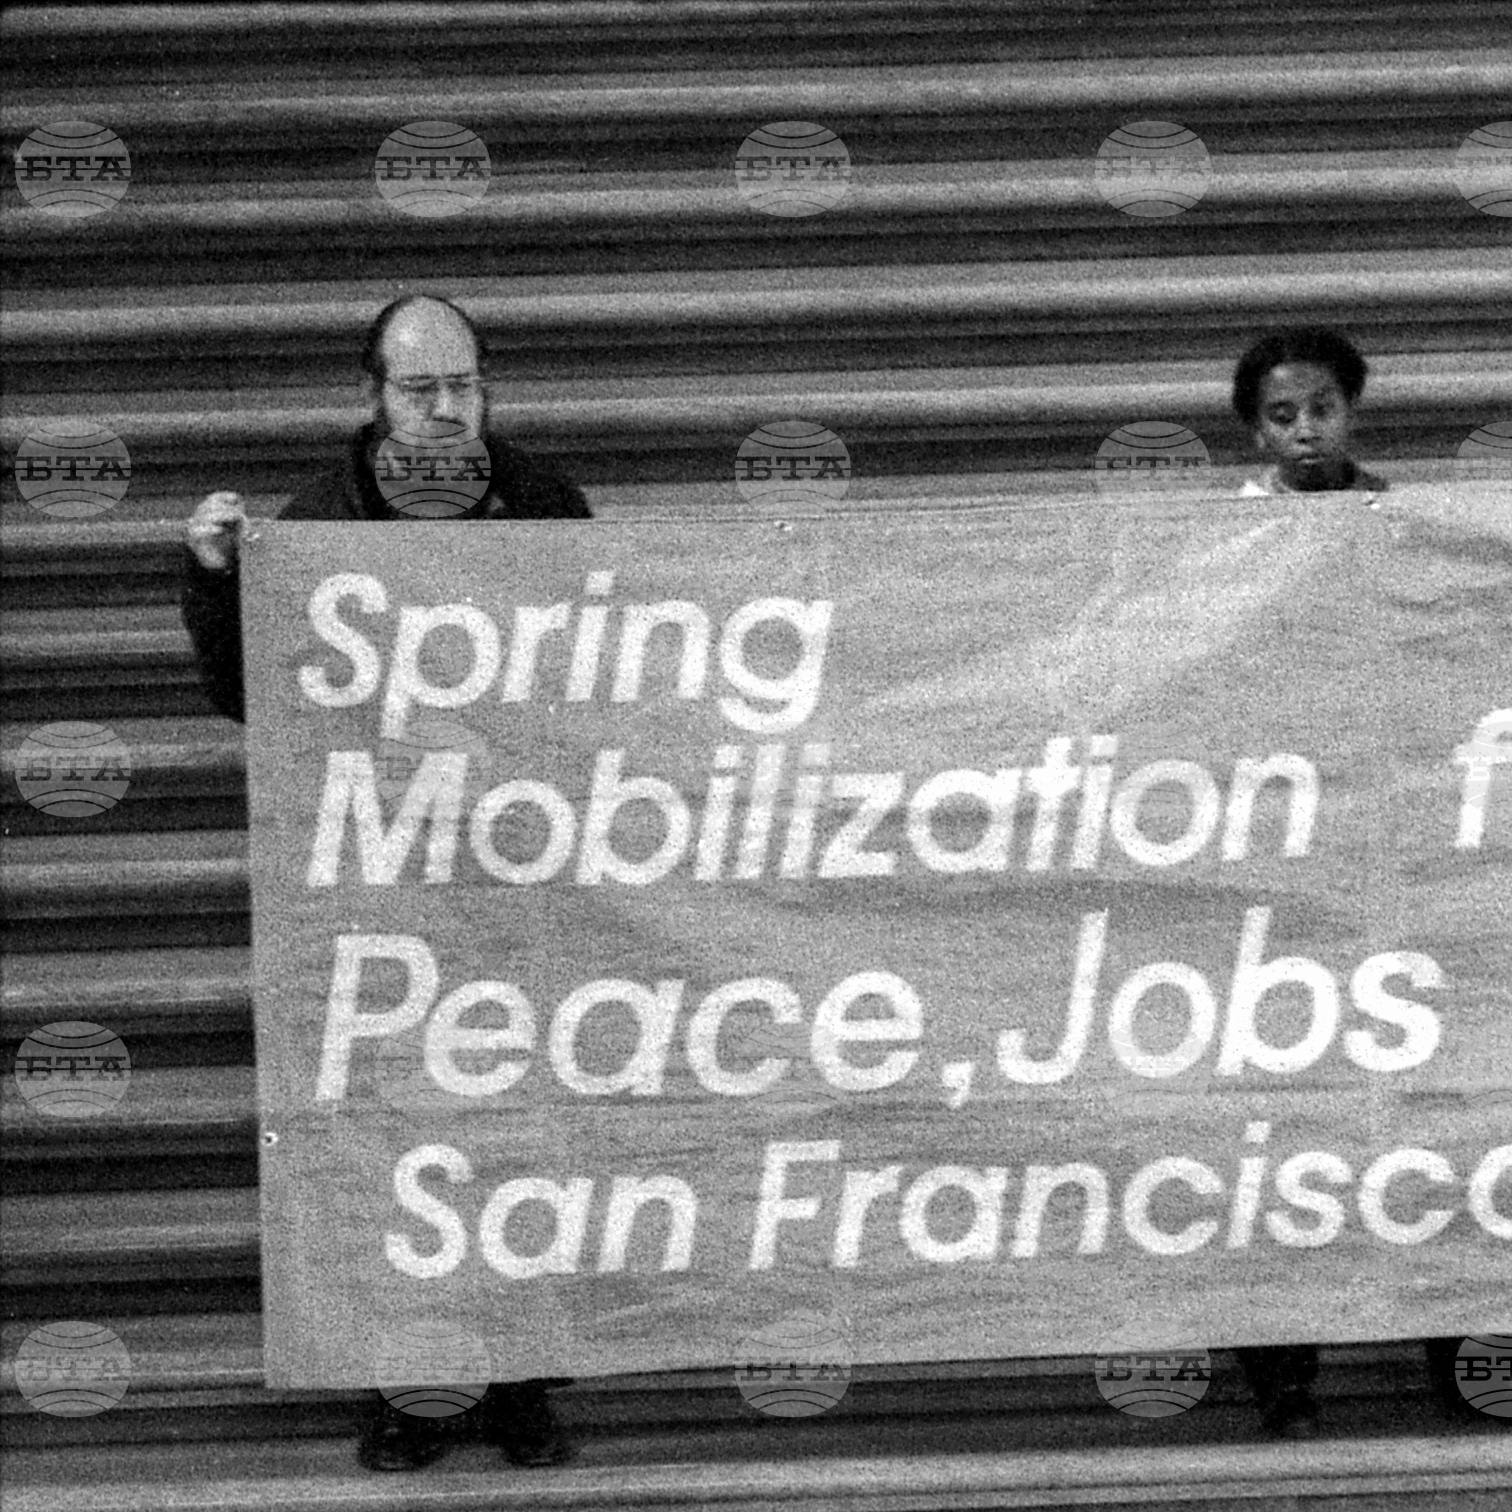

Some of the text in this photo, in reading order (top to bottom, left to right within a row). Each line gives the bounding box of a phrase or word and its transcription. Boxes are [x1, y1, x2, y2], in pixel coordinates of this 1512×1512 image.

[297, 570, 834, 738] Spring
[306, 735, 1319, 887] Mobilization
[384, 1145, 698, 1279] San
